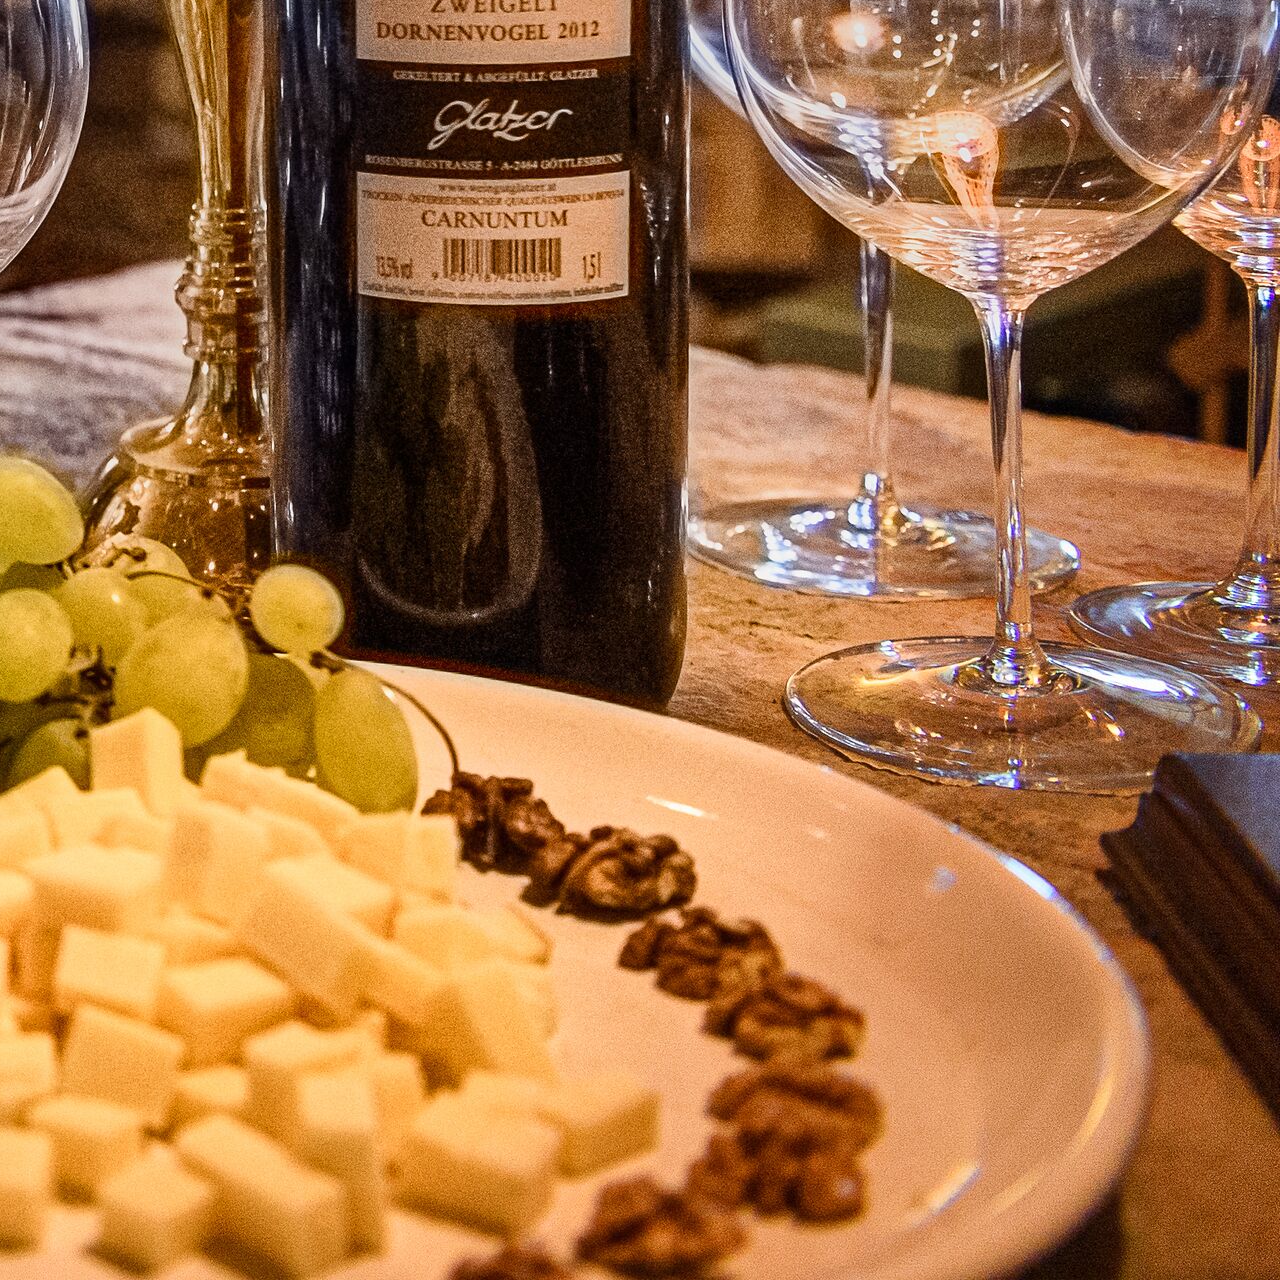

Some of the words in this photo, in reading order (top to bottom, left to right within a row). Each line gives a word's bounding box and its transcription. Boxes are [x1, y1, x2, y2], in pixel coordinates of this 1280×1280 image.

[376, 21, 550, 42] DORNENVOGEL
[557, 19, 601, 39] 2012
[420, 209, 569, 230] CARNUNTUM
